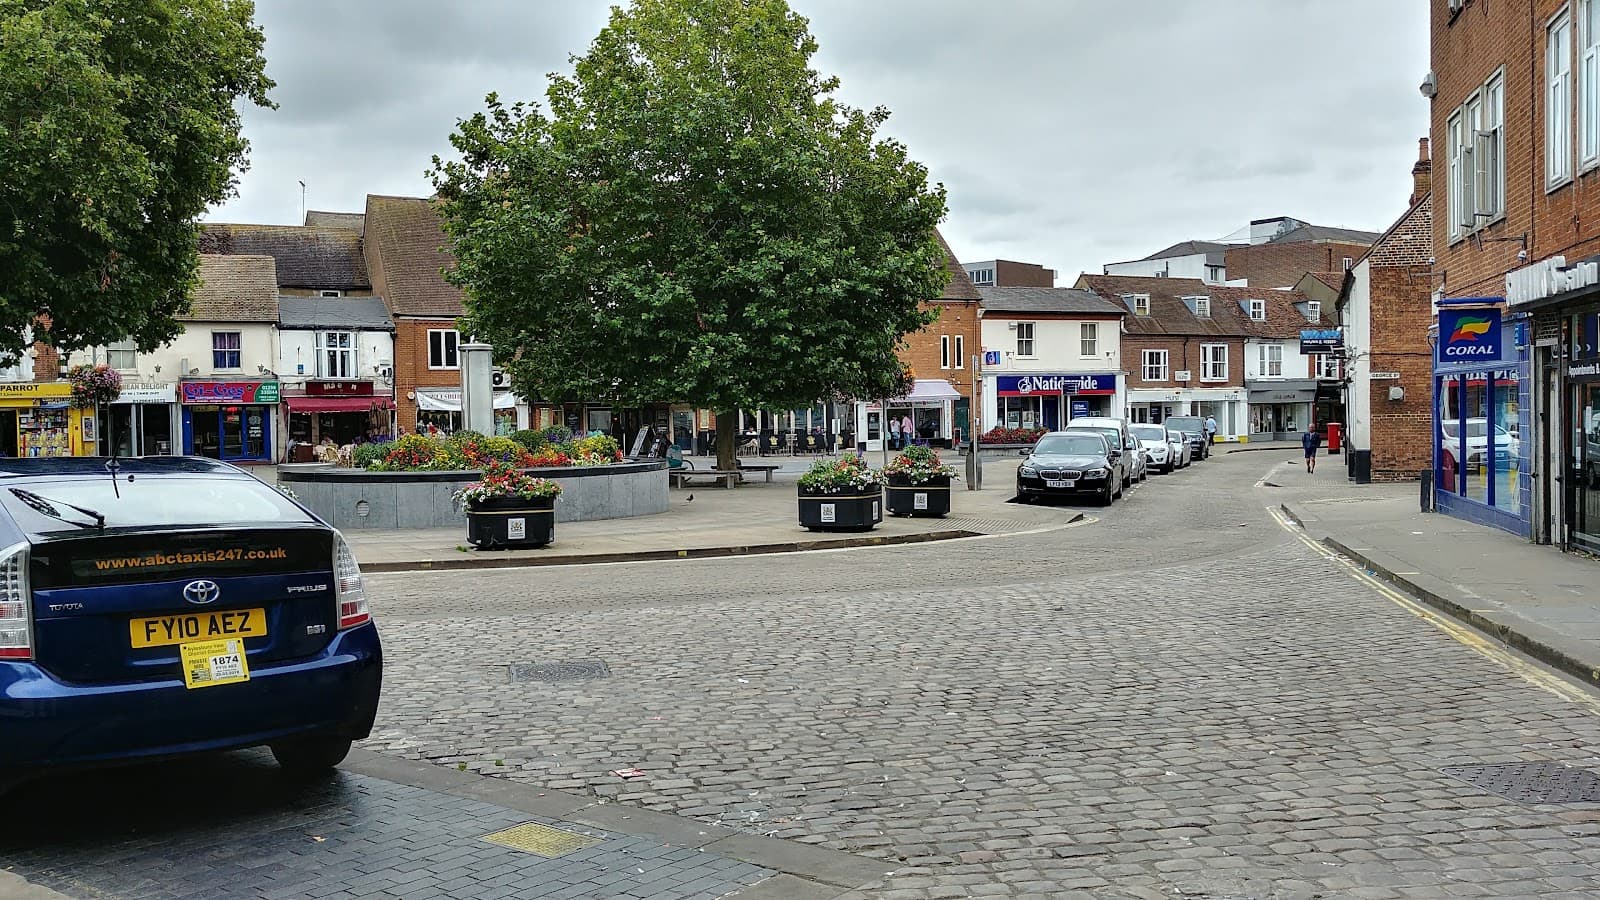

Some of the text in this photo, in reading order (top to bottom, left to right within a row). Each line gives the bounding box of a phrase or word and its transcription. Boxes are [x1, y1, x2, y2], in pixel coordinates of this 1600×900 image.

[1446, 345, 1495, 356] CORAL
[1568, 363, 1596, 378] Appointments
[95, 547, 287, 570] www.abctaxis247.co.uk
[287, 584, 327, 593] PRIUS
[49, 603, 84, 611] TOYOTA
[145, 612, 251, 641] FY10 AEZ
[212, 655, 239, 665] 1874
